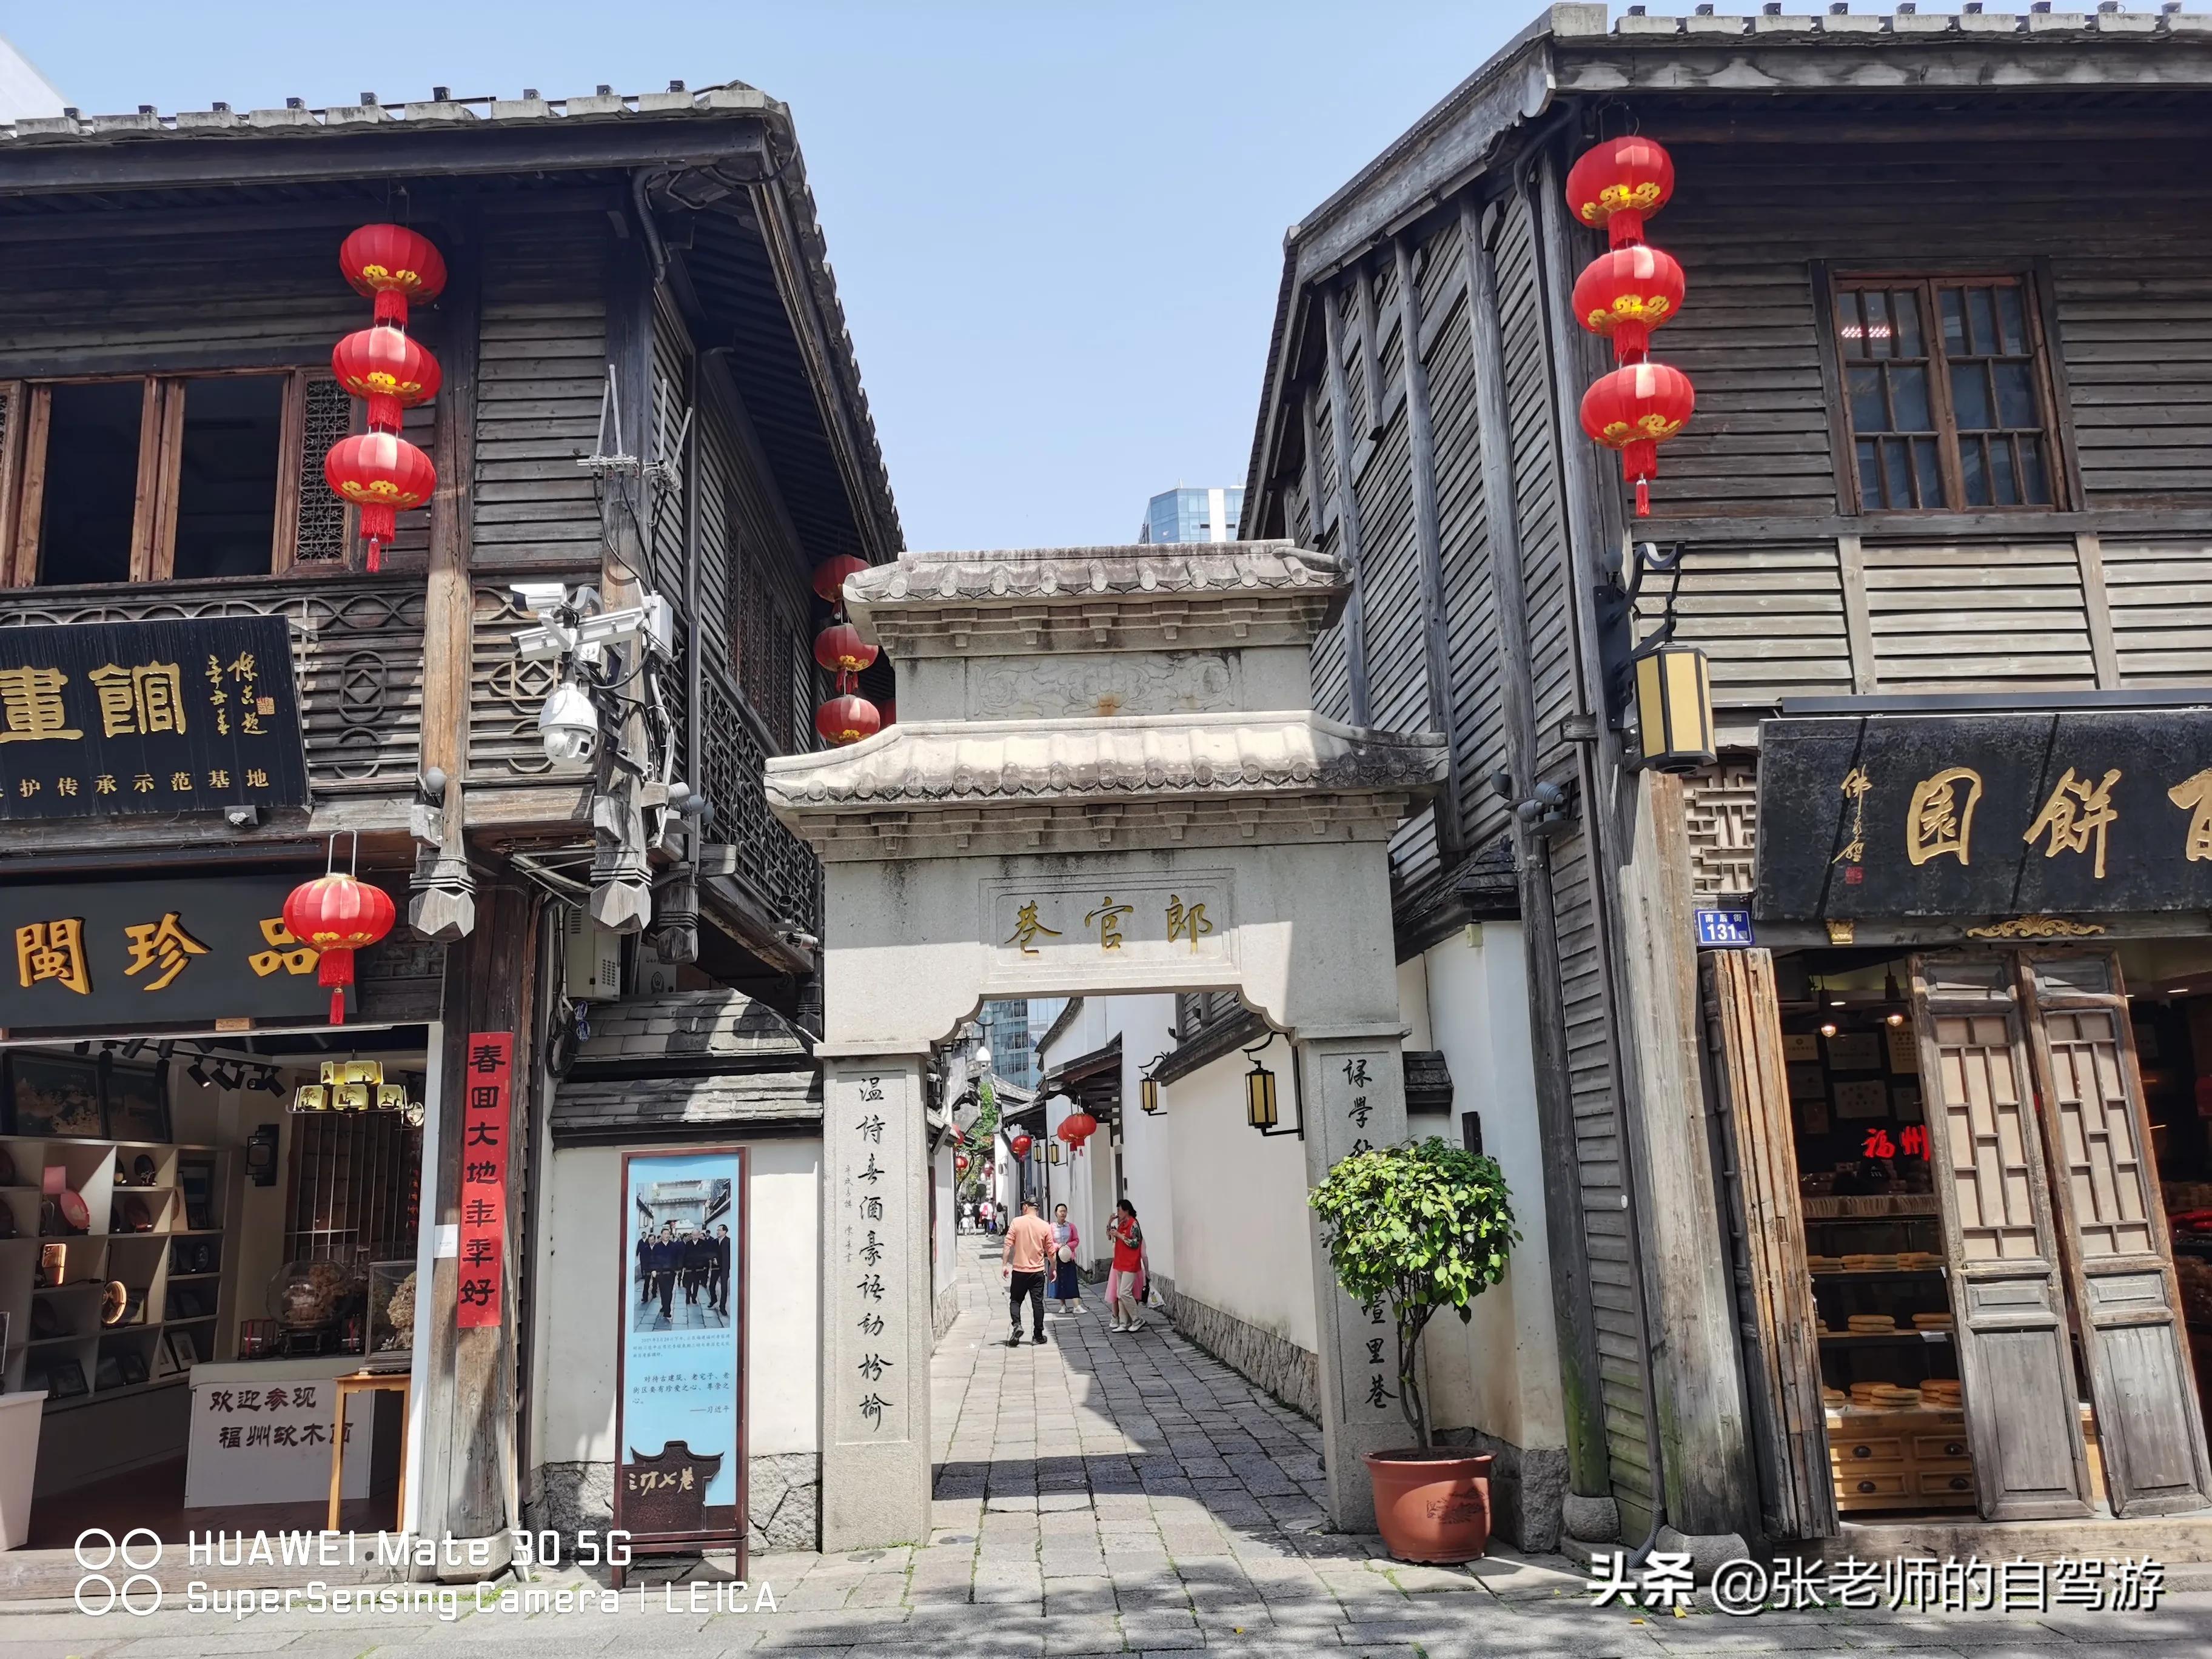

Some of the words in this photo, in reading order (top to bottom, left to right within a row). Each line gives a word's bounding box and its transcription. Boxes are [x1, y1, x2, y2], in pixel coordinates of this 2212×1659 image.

[0, 768, 269, 798] 护传承示范基地
[1704, 914, 1742, 922] 南后街
[1707, 923, 1736, 940] 131
[209, 1387, 317, 1413] 欢迎参观
